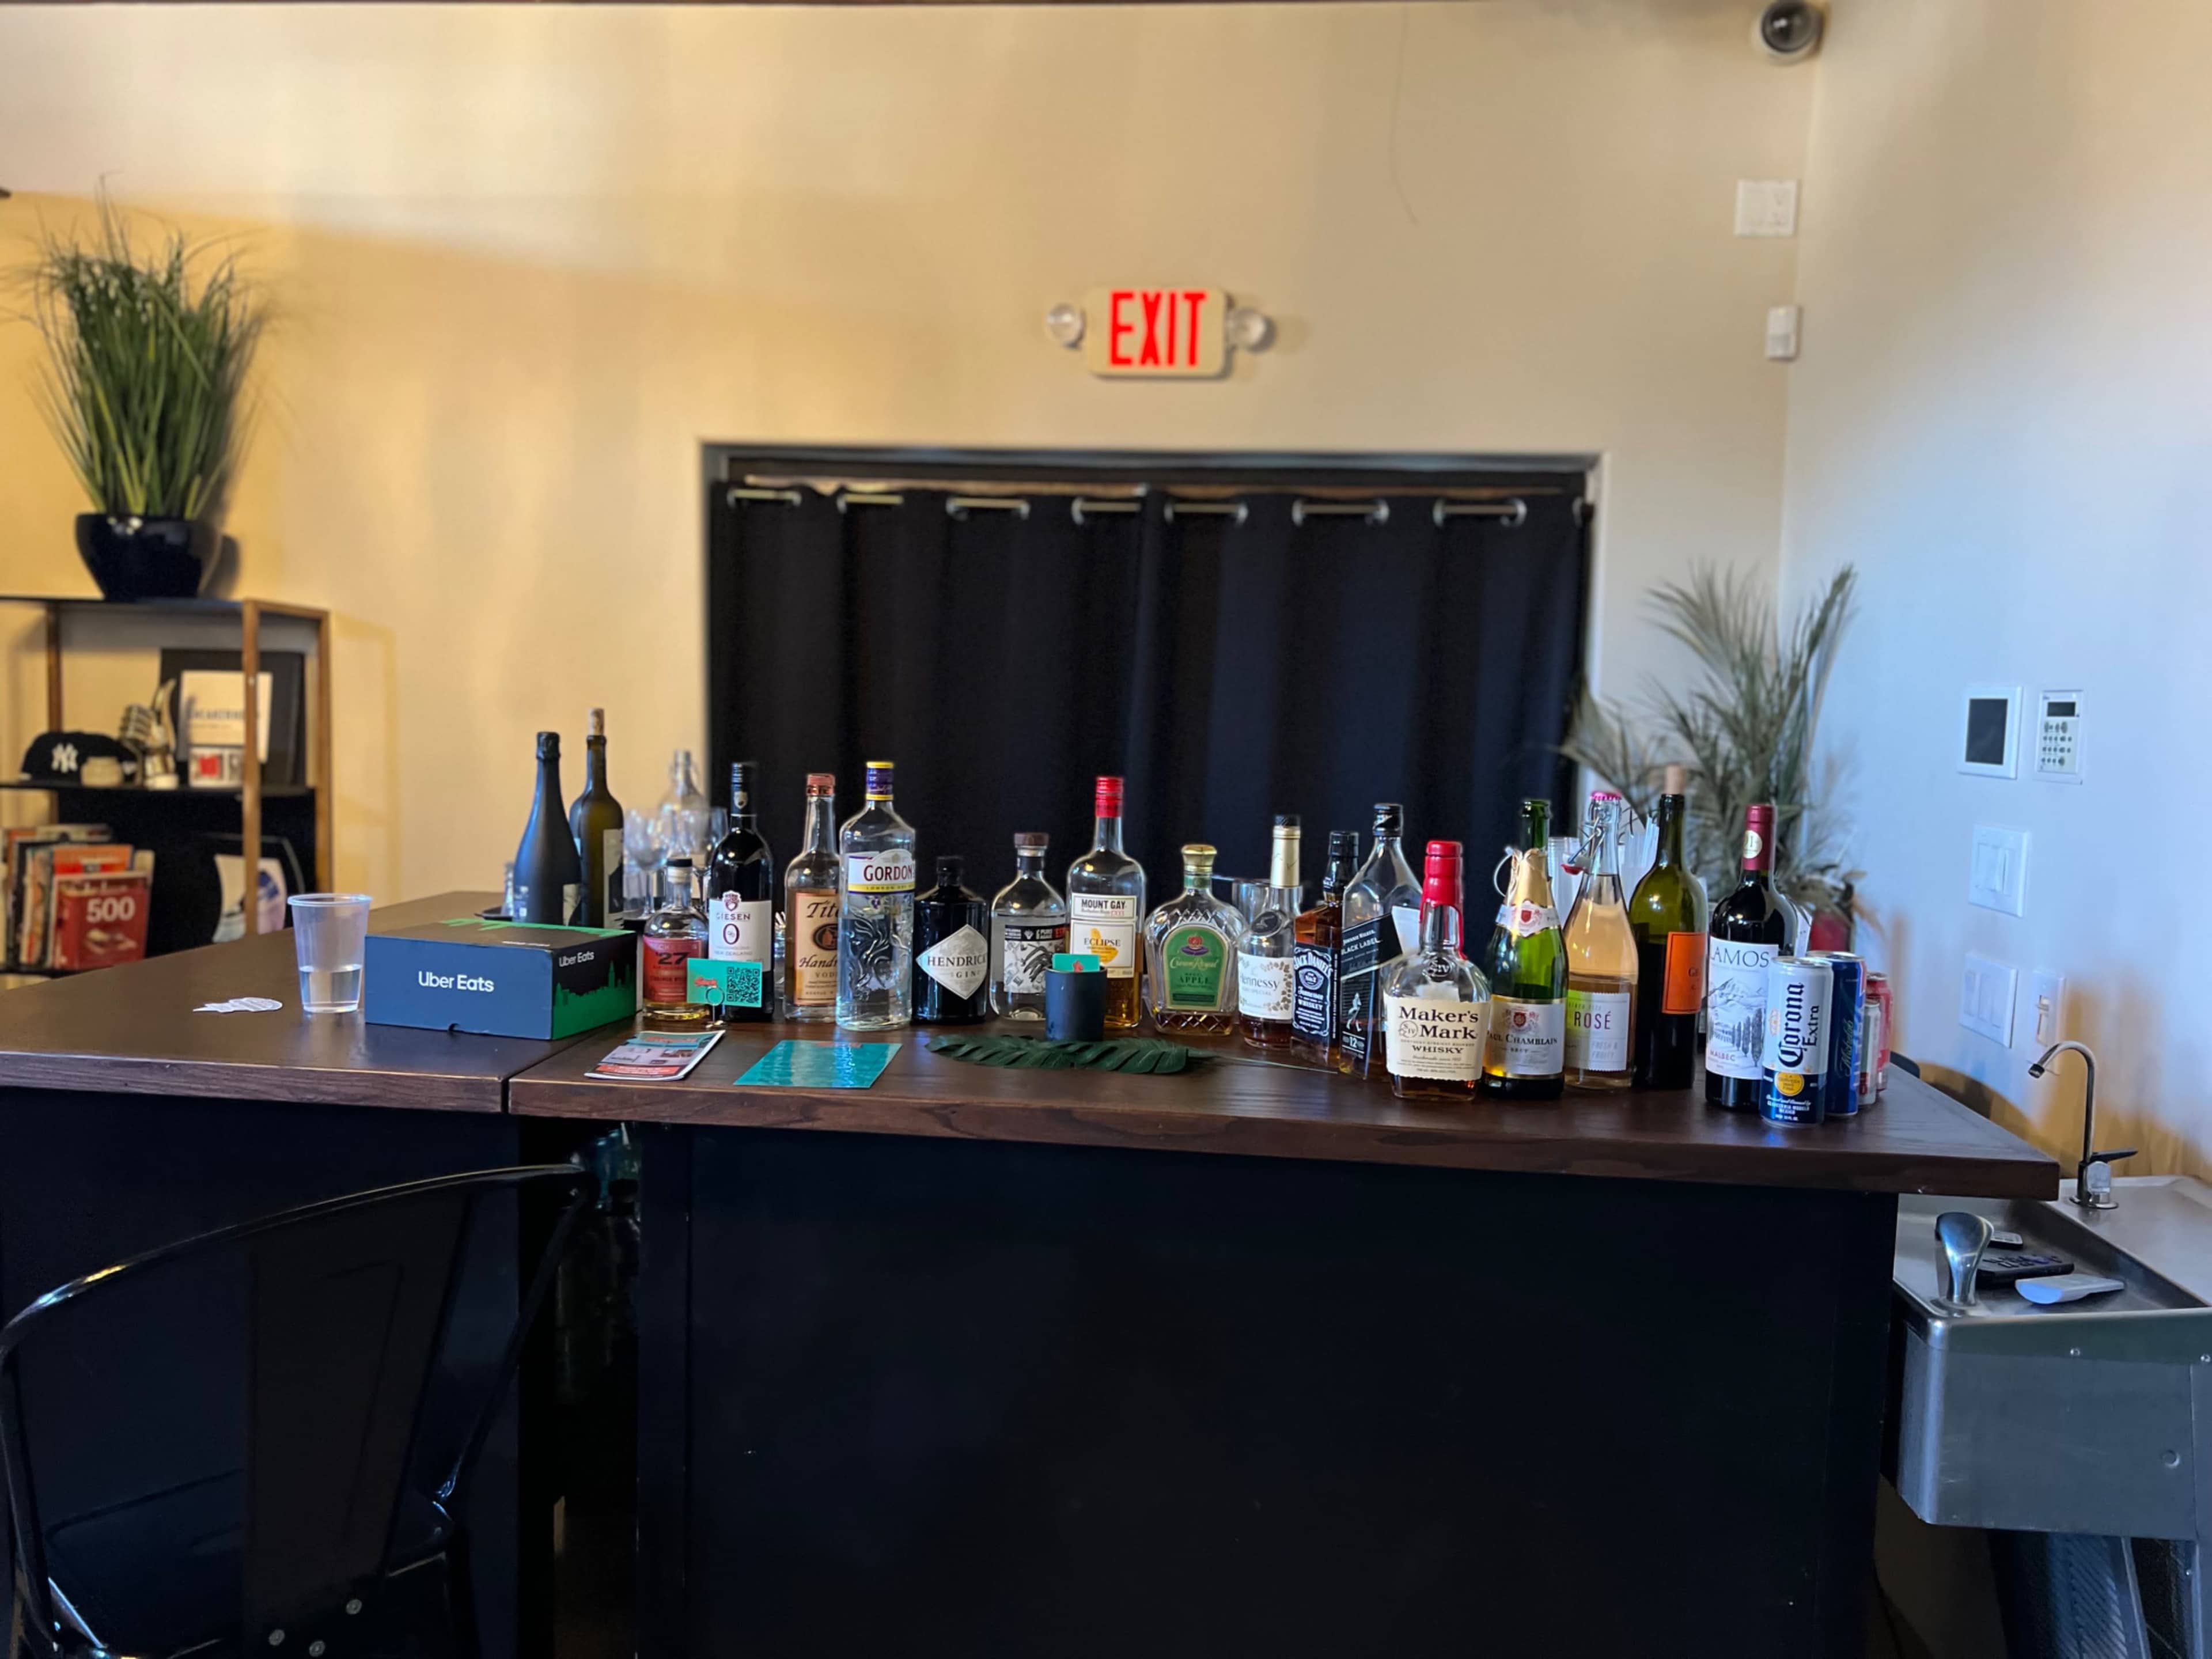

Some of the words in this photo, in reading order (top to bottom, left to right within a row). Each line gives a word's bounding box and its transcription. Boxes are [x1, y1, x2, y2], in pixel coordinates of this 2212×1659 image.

[1109, 291, 1207, 366] EXIT
[86, 896, 136, 923] 500
[806, 902, 839, 918] Tit
[1081, 899, 1108, 909] MOUNT
[1111, 900, 1126, 909] GAY
[1084, 937, 1121, 947] ECLIPSE
[559, 956, 576, 967] Uber
[578, 951, 594, 963] Eats
[798, 954, 837, 968] Hand
[418, 971, 454, 988] Uber
[457, 975, 494, 993] Eats
[1180, 976, 1209, 984] APPLE
[1399, 1006, 1479, 1022] Maker's
[1574, 1010, 1611, 1030] ROSÉ
[1421, 1024, 1476, 1039] Mark
[1778, 982, 1805, 1068] Corona
[1805, 1005, 1820, 1047] Extra
[1350, 1036, 1357, 1048] 12
[1412, 1045, 1463, 1054] WHISKY
[1709, 1050, 1736, 1062] MALBEC
